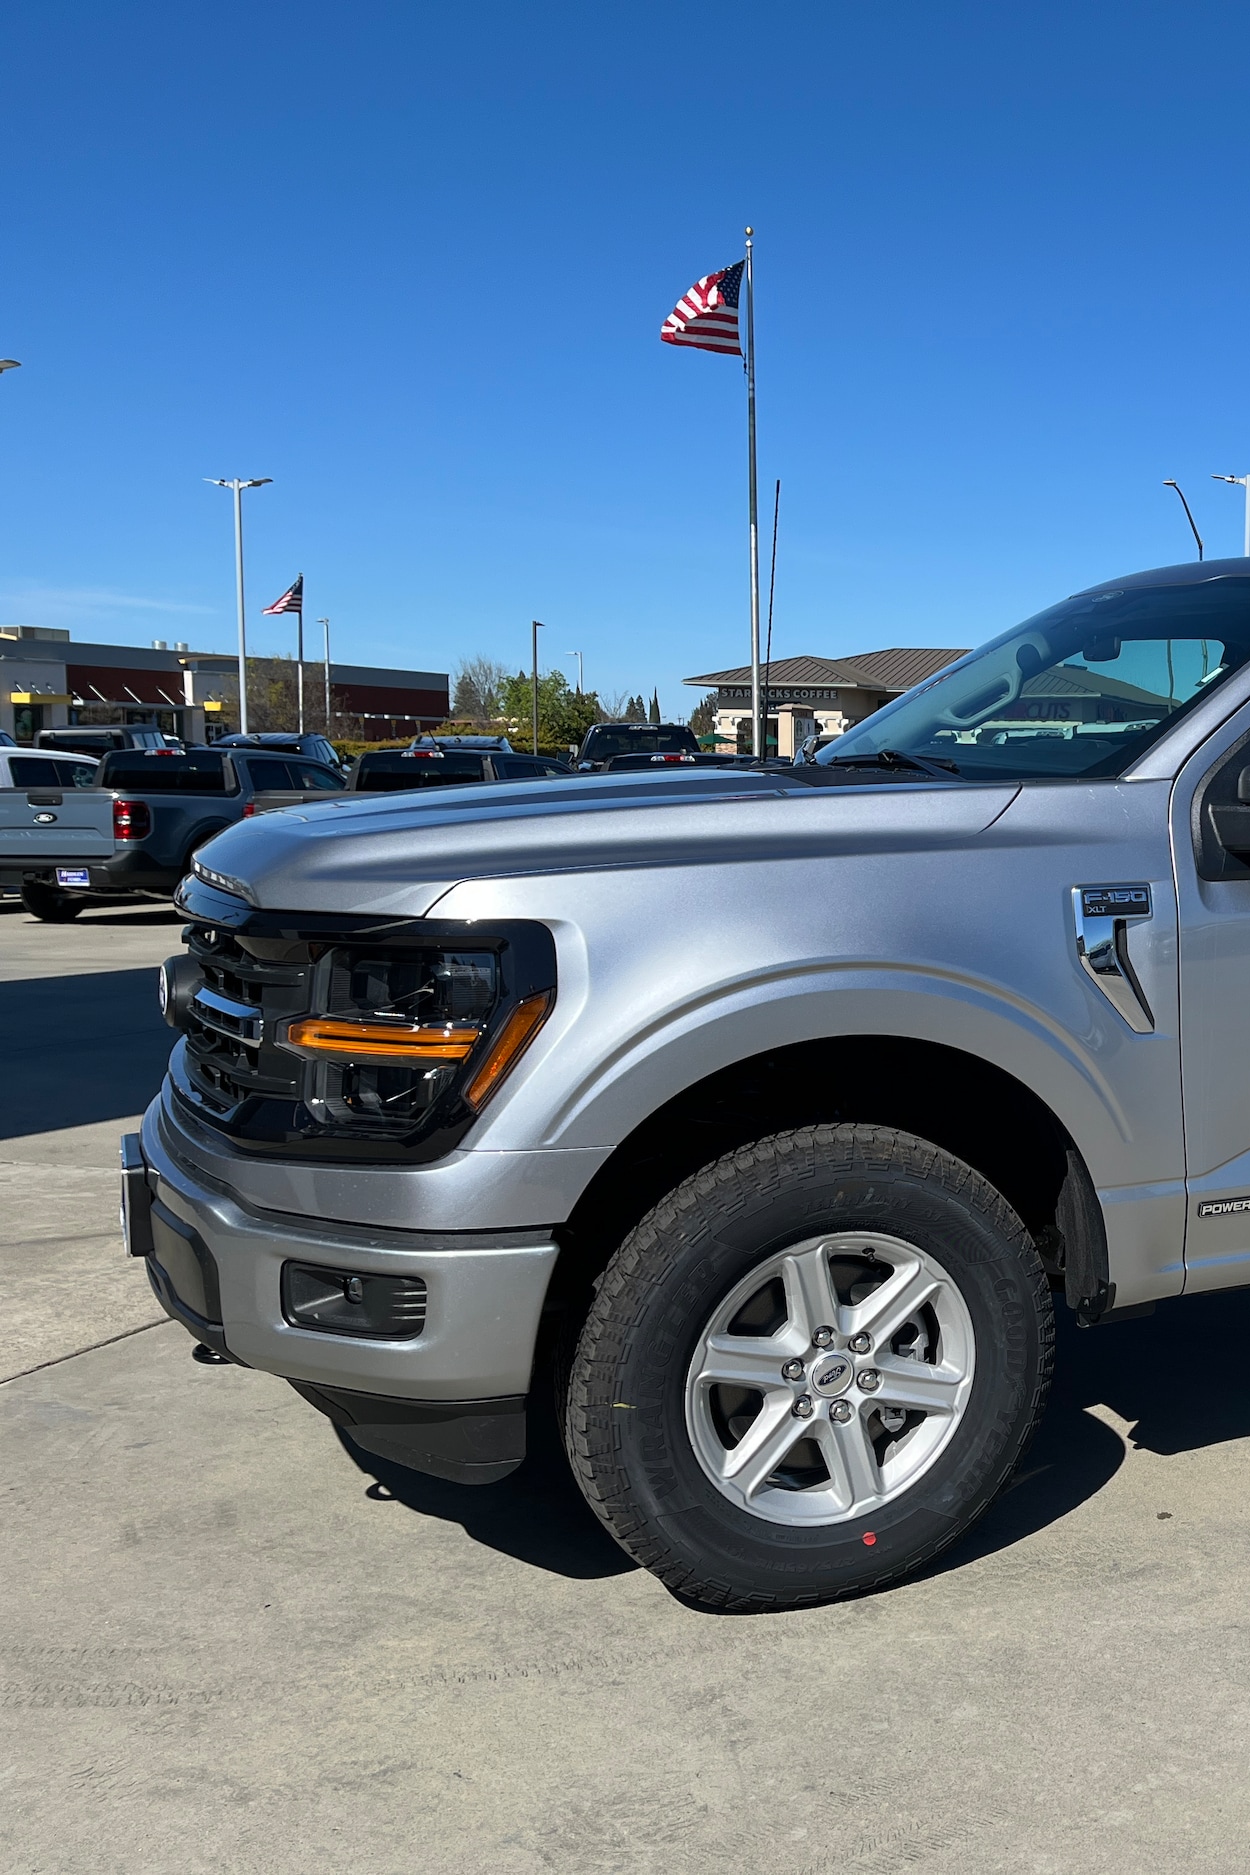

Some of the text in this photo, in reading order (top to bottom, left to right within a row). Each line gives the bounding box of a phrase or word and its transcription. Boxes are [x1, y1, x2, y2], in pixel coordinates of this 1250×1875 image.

[721, 688, 838, 699] STARUCKS COFFEE
[1084, 889, 1148, 905] F-150
[1087, 905, 1107, 914] XLT
